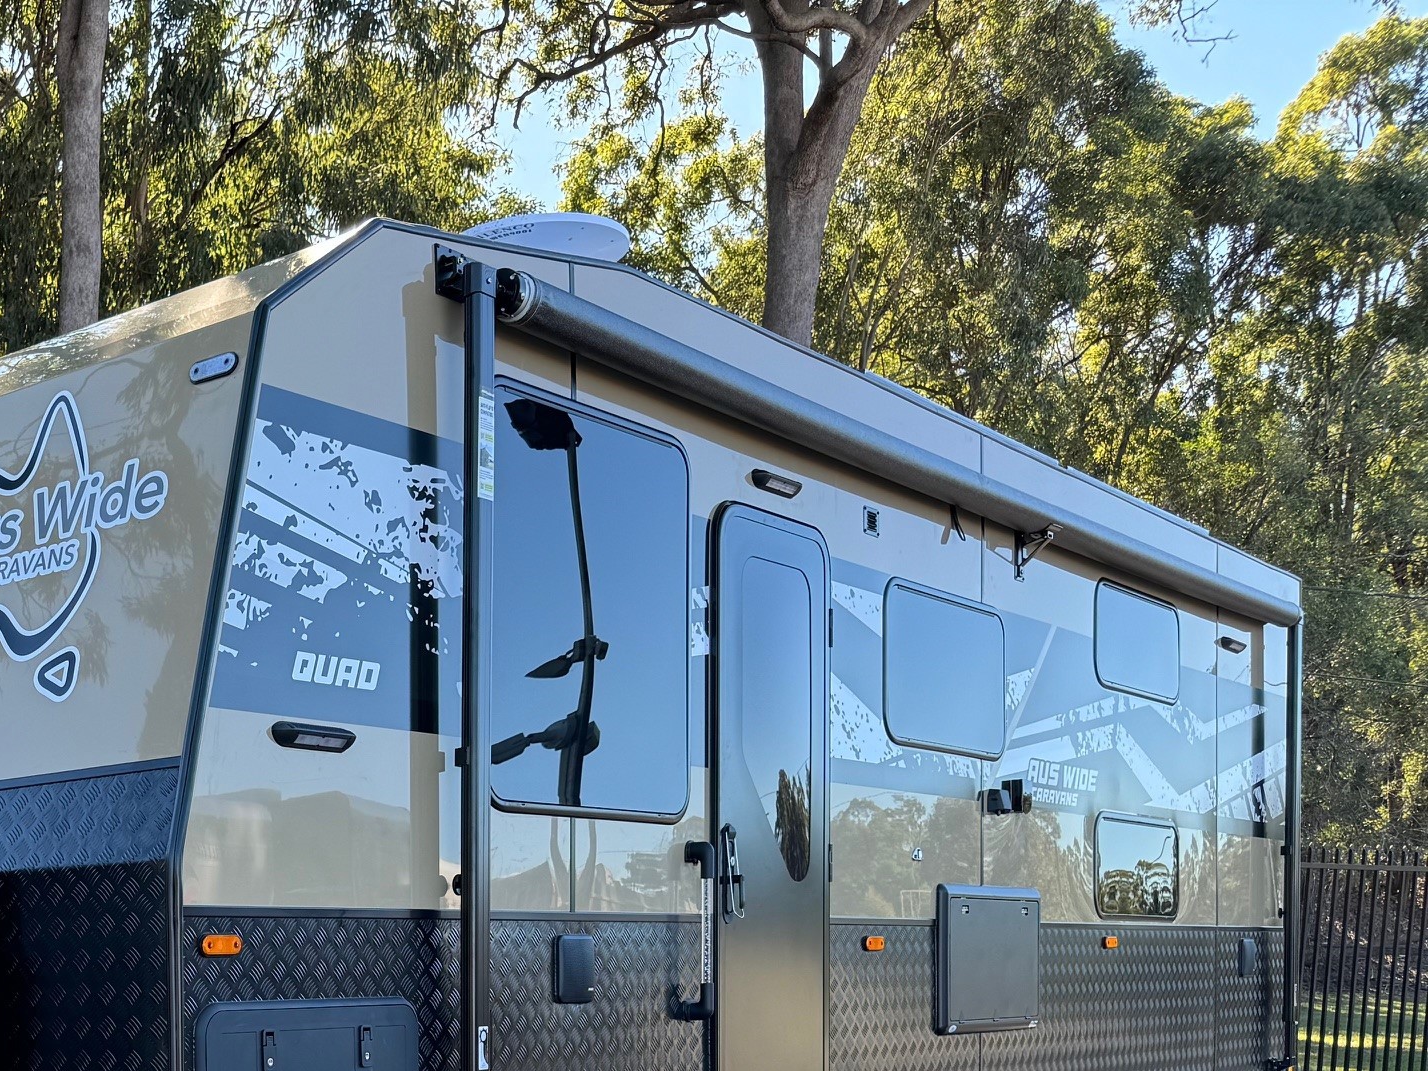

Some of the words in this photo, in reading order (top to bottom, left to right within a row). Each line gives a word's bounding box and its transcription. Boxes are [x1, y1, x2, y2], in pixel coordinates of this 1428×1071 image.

[34, 461, 165, 542] Wide
[292, 650, 381, 691] QUAD
[1027, 759, 1061, 787] AUS
[1062, 764, 1099, 792] WIDE
[1031, 786, 1079, 807] CARAVANS
